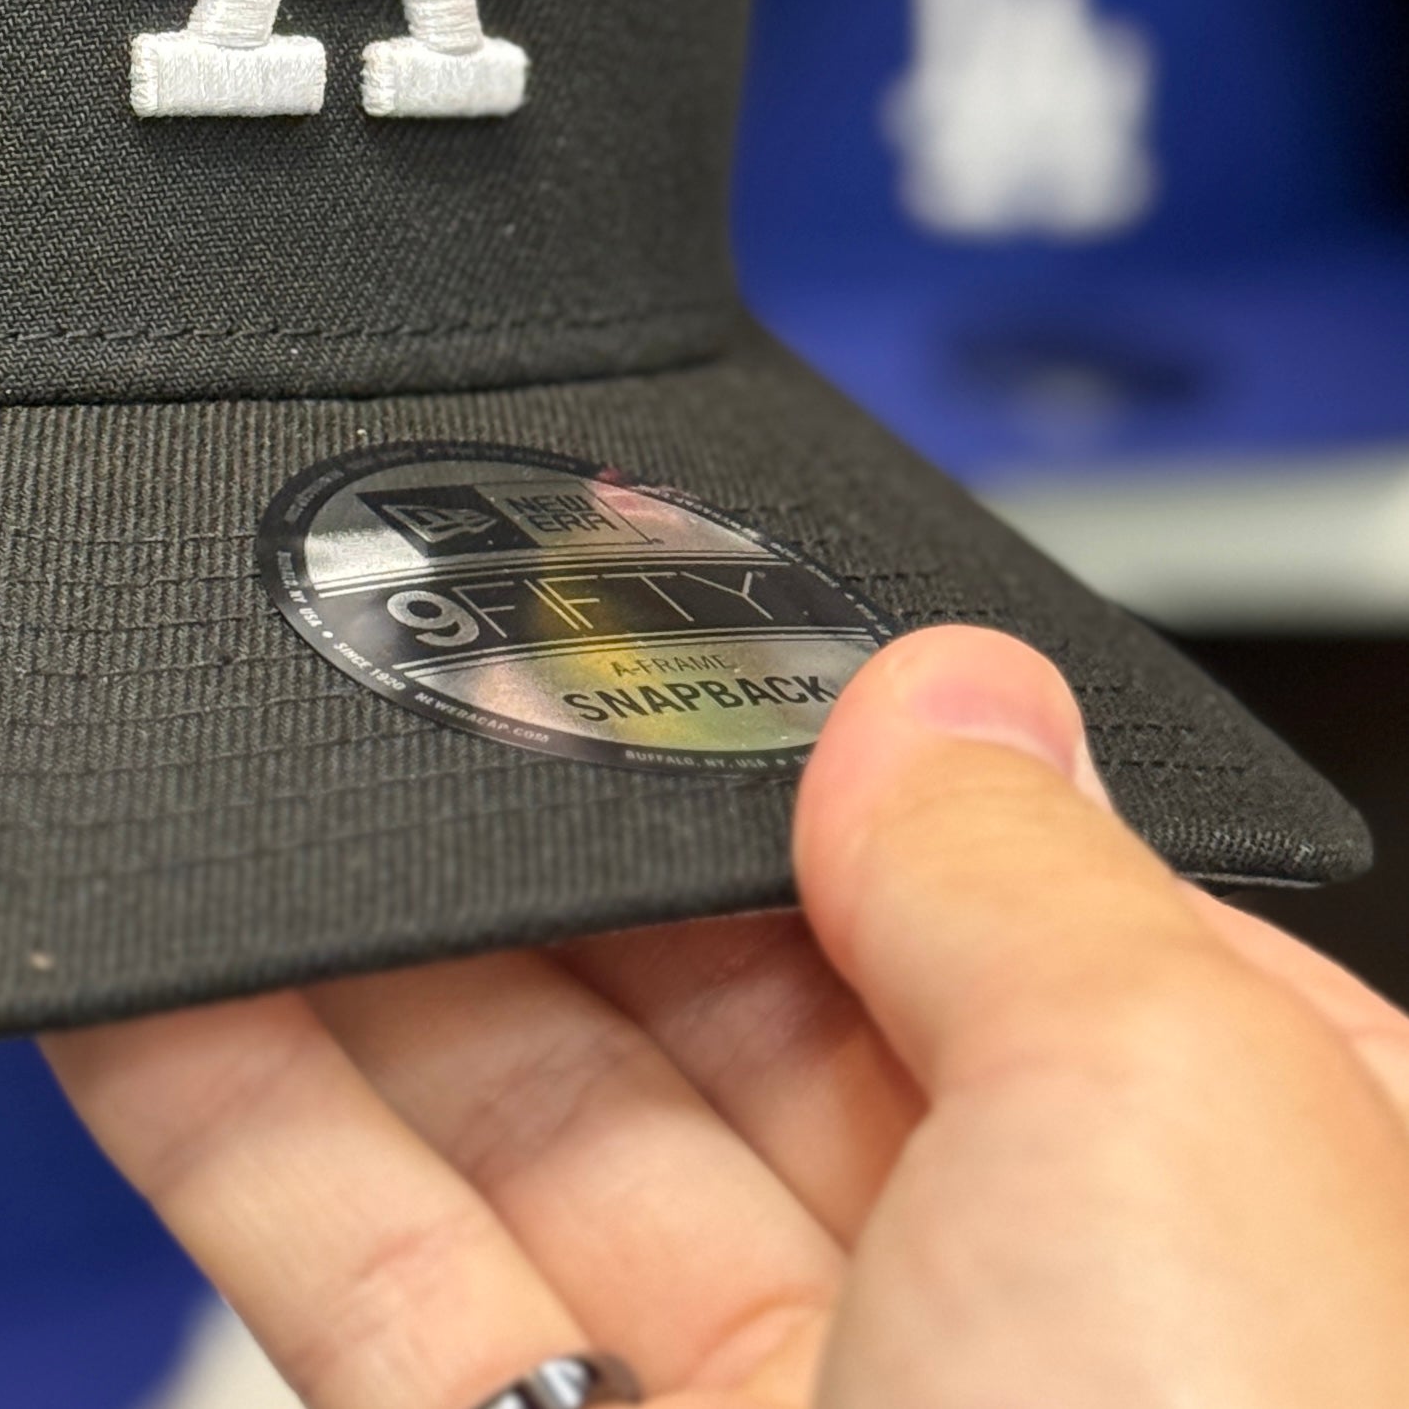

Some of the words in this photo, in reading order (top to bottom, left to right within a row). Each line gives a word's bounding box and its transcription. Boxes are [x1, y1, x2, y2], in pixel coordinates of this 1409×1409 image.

[504, 494, 594, 513] NEW
[528, 511, 619, 532] ERA
[386, 570, 773, 646] 9FIFTY
[299, 607, 323, 628] USA
[333, 642, 373, 669] SINCE
[369, 667, 407, 692] 1920
[611, 654, 736, 678] A-FRAME
[563, 675, 838, 722] SNAPBACK
[414, 691, 550, 743] NEWERACAP.COM
[736, 758, 768, 770] USA
